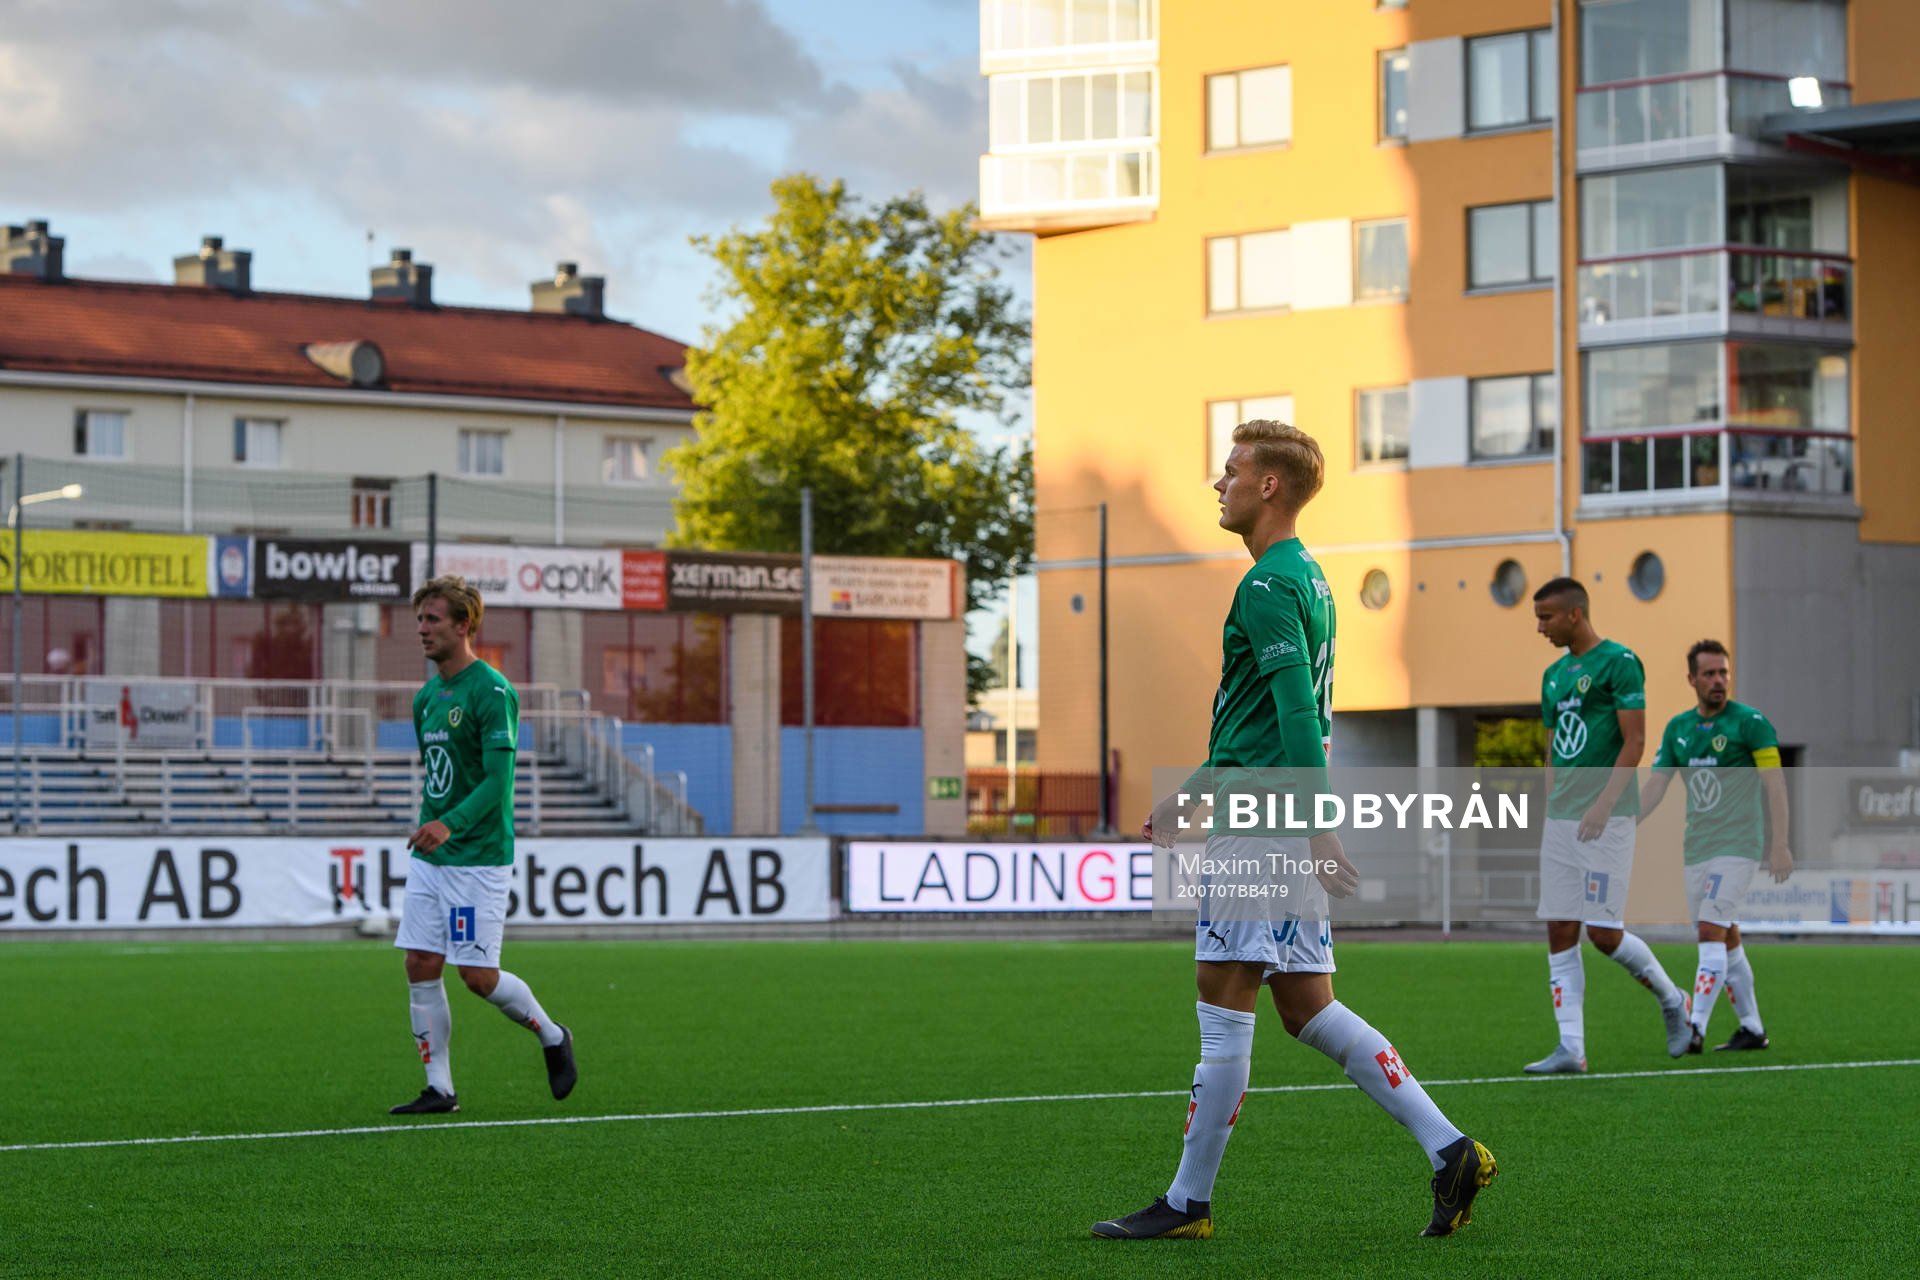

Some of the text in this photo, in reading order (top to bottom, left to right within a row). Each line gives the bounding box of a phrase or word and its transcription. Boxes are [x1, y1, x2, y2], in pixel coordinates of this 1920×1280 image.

[266, 543, 399, 582] bowler
[671, 562, 804, 590] xerman.se
[1260, 645, 1298, 661] WELLNESS
[1263, 640, 1289, 654] NORDIC
[138, 849, 242, 919] AB
[695, 849, 785, 915] AB
